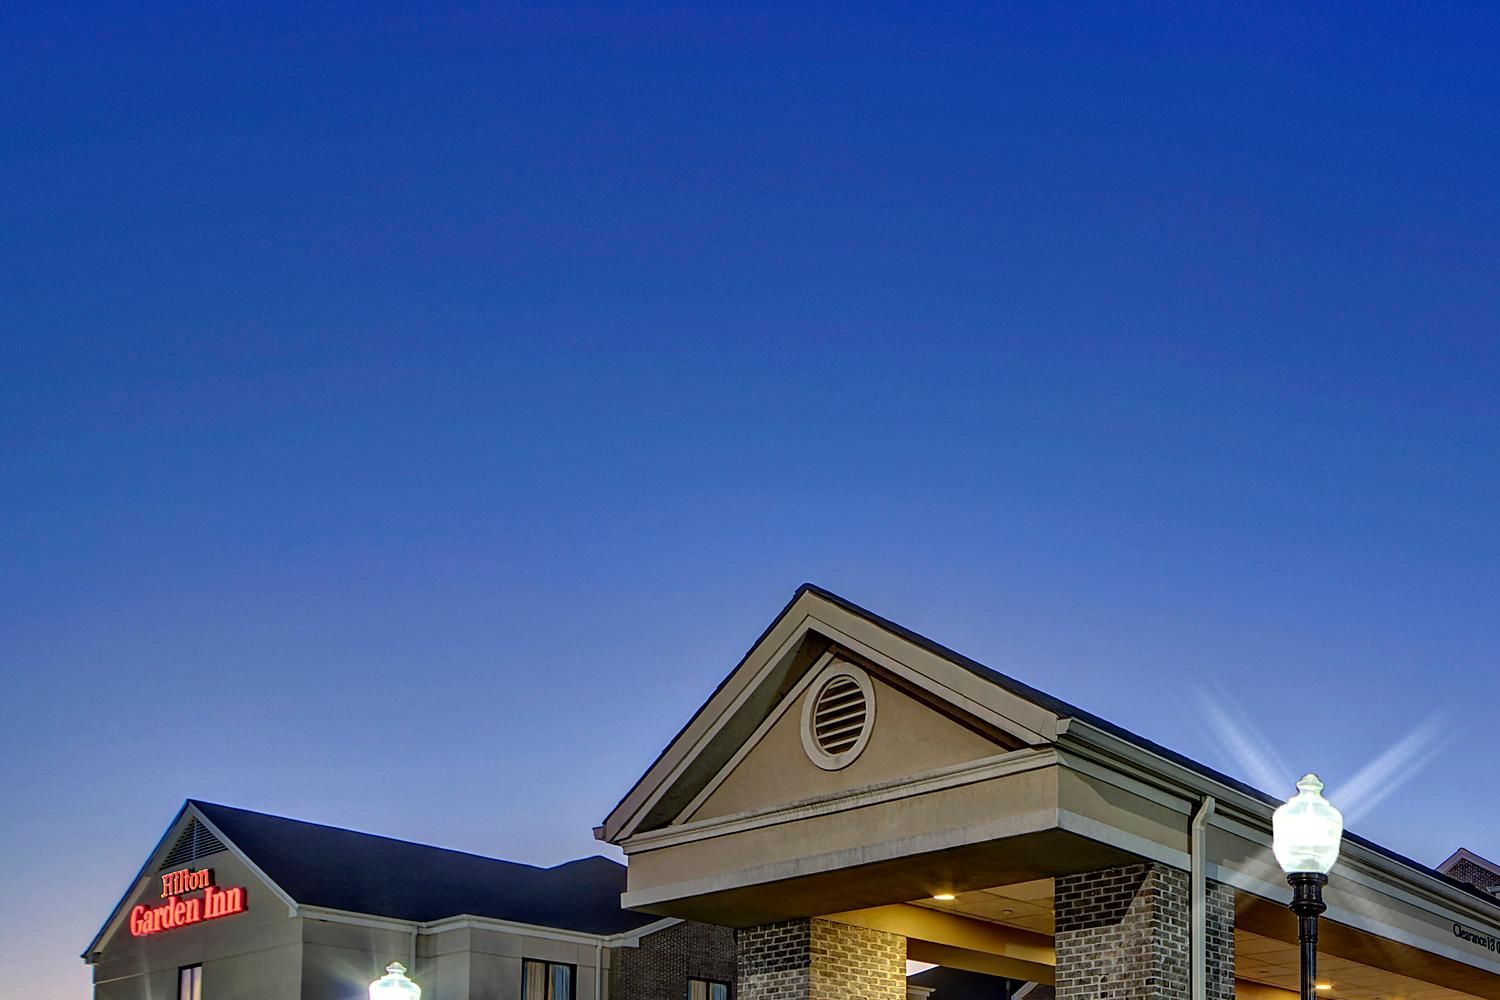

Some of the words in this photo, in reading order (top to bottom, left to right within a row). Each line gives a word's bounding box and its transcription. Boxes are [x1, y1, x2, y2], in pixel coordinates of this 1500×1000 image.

[161, 868, 210, 898] Hilton
[129, 896, 201, 937] Garden
[203, 886, 243, 919] Inn
[1453, 923, 1487, 948] Clearance
